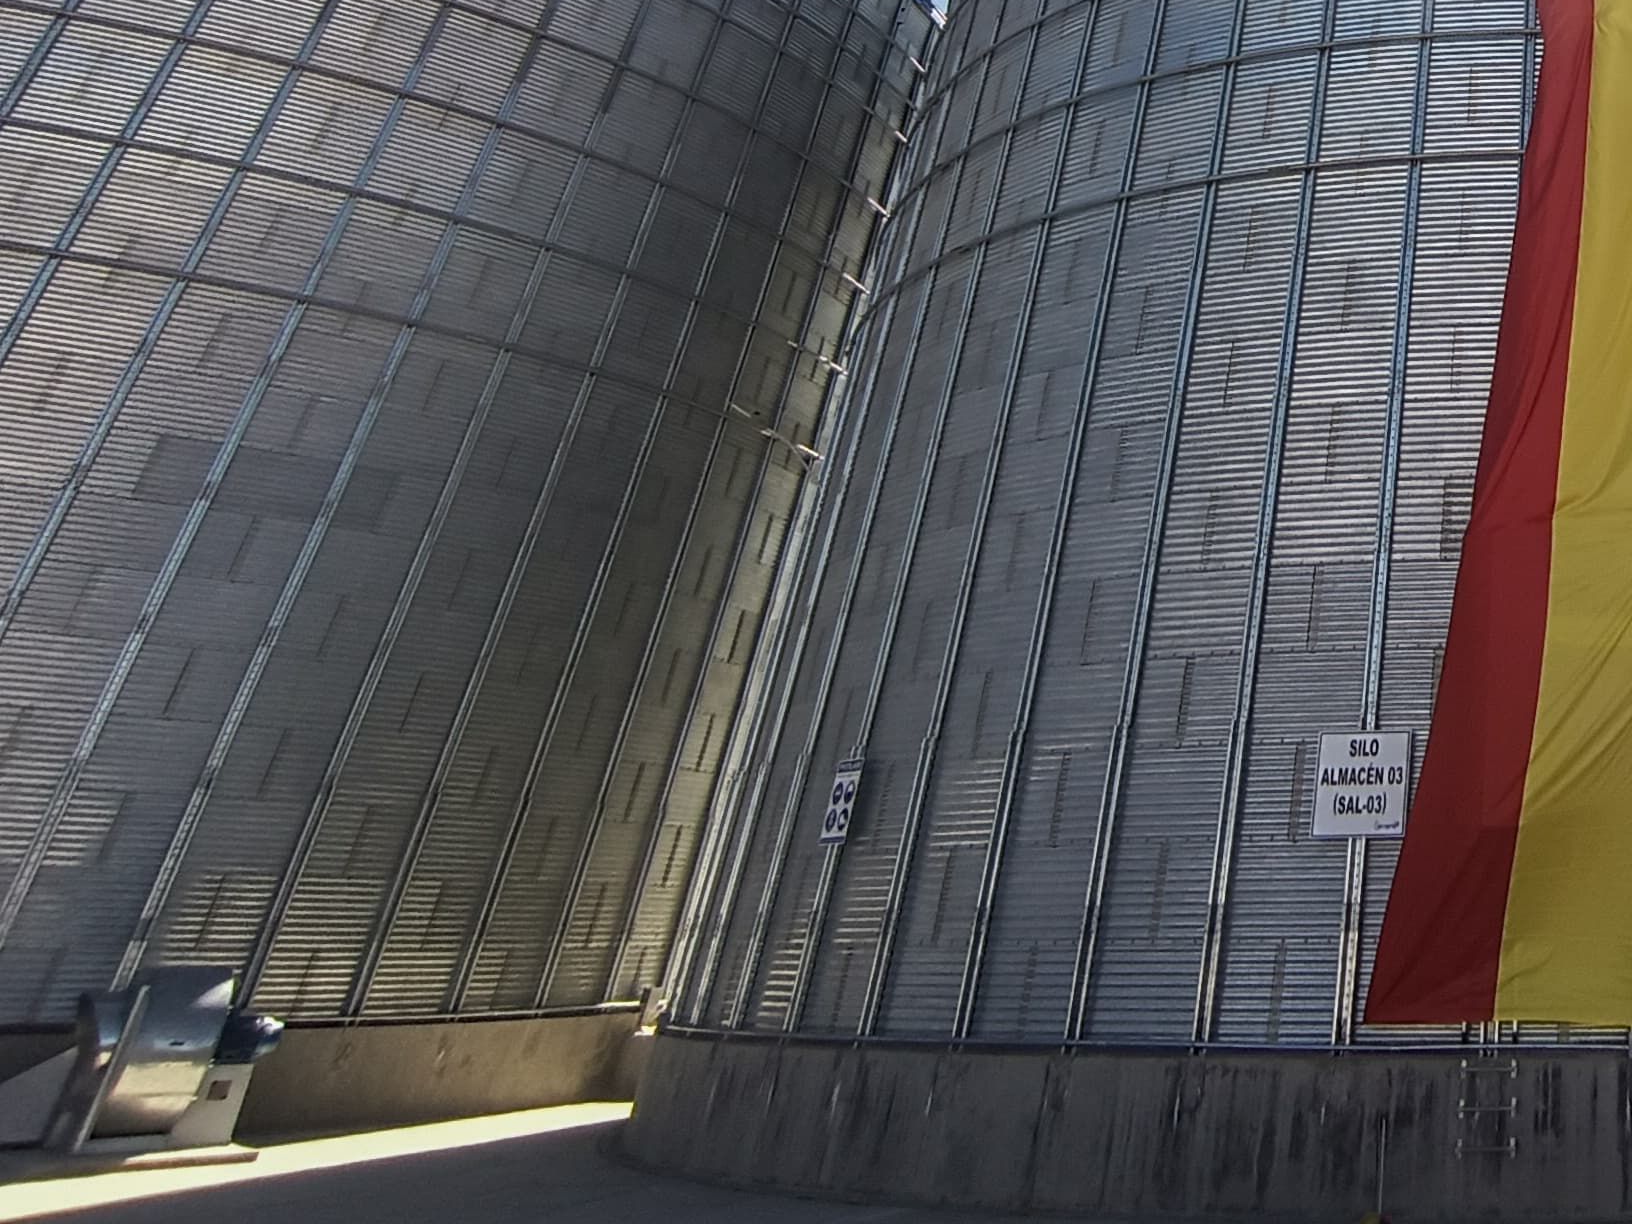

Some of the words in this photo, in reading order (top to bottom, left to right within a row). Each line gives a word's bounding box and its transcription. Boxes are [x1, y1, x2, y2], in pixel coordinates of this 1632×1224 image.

[1349, 738, 1380, 757] SILO
[1320, 762, 1384, 786] ALMACÉN
[1387, 766, 1404, 785] 03
[1333, 792, 1387, 815] (SAL-03)
